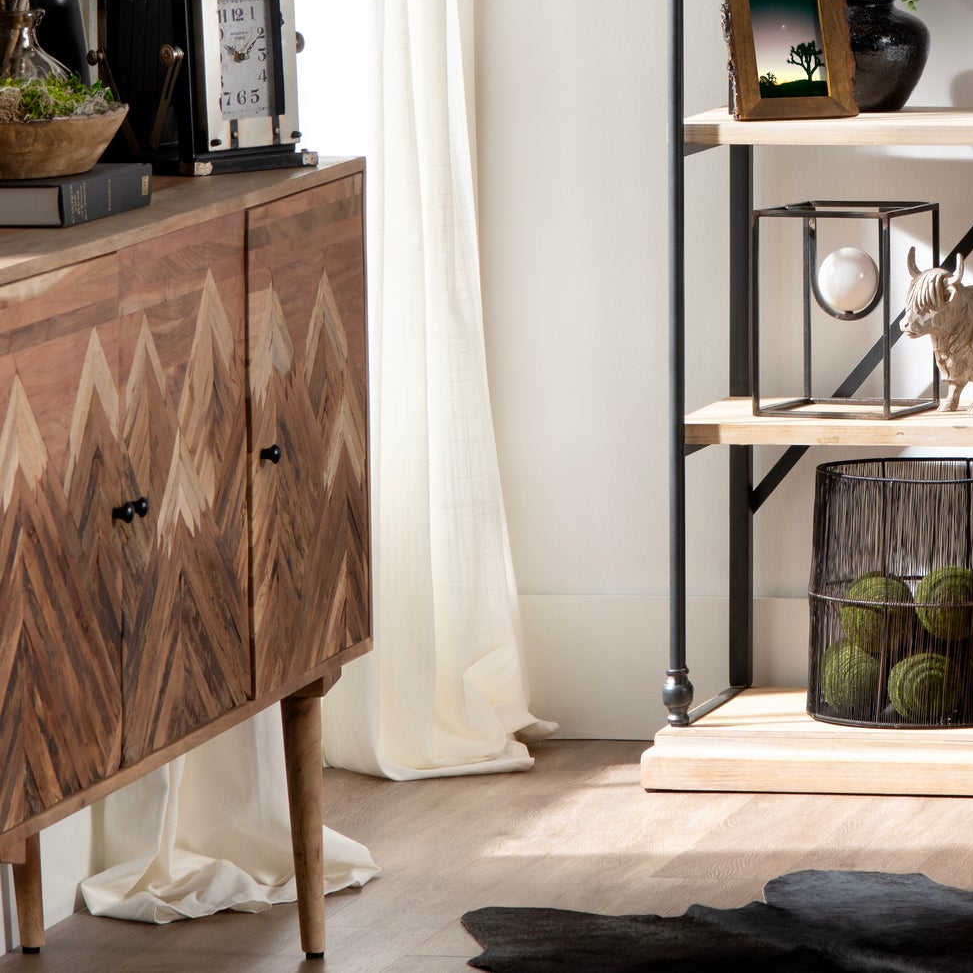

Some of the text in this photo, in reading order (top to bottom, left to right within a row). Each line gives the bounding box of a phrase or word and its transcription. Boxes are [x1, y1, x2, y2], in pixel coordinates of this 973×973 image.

[232, 7, 244, 22] 12
[256, 27, 265, 39] 2
[258, 48, 266, 61] 3
[258, 69, 266, 83] 4
[223, 89, 260, 106] 7 6 5
